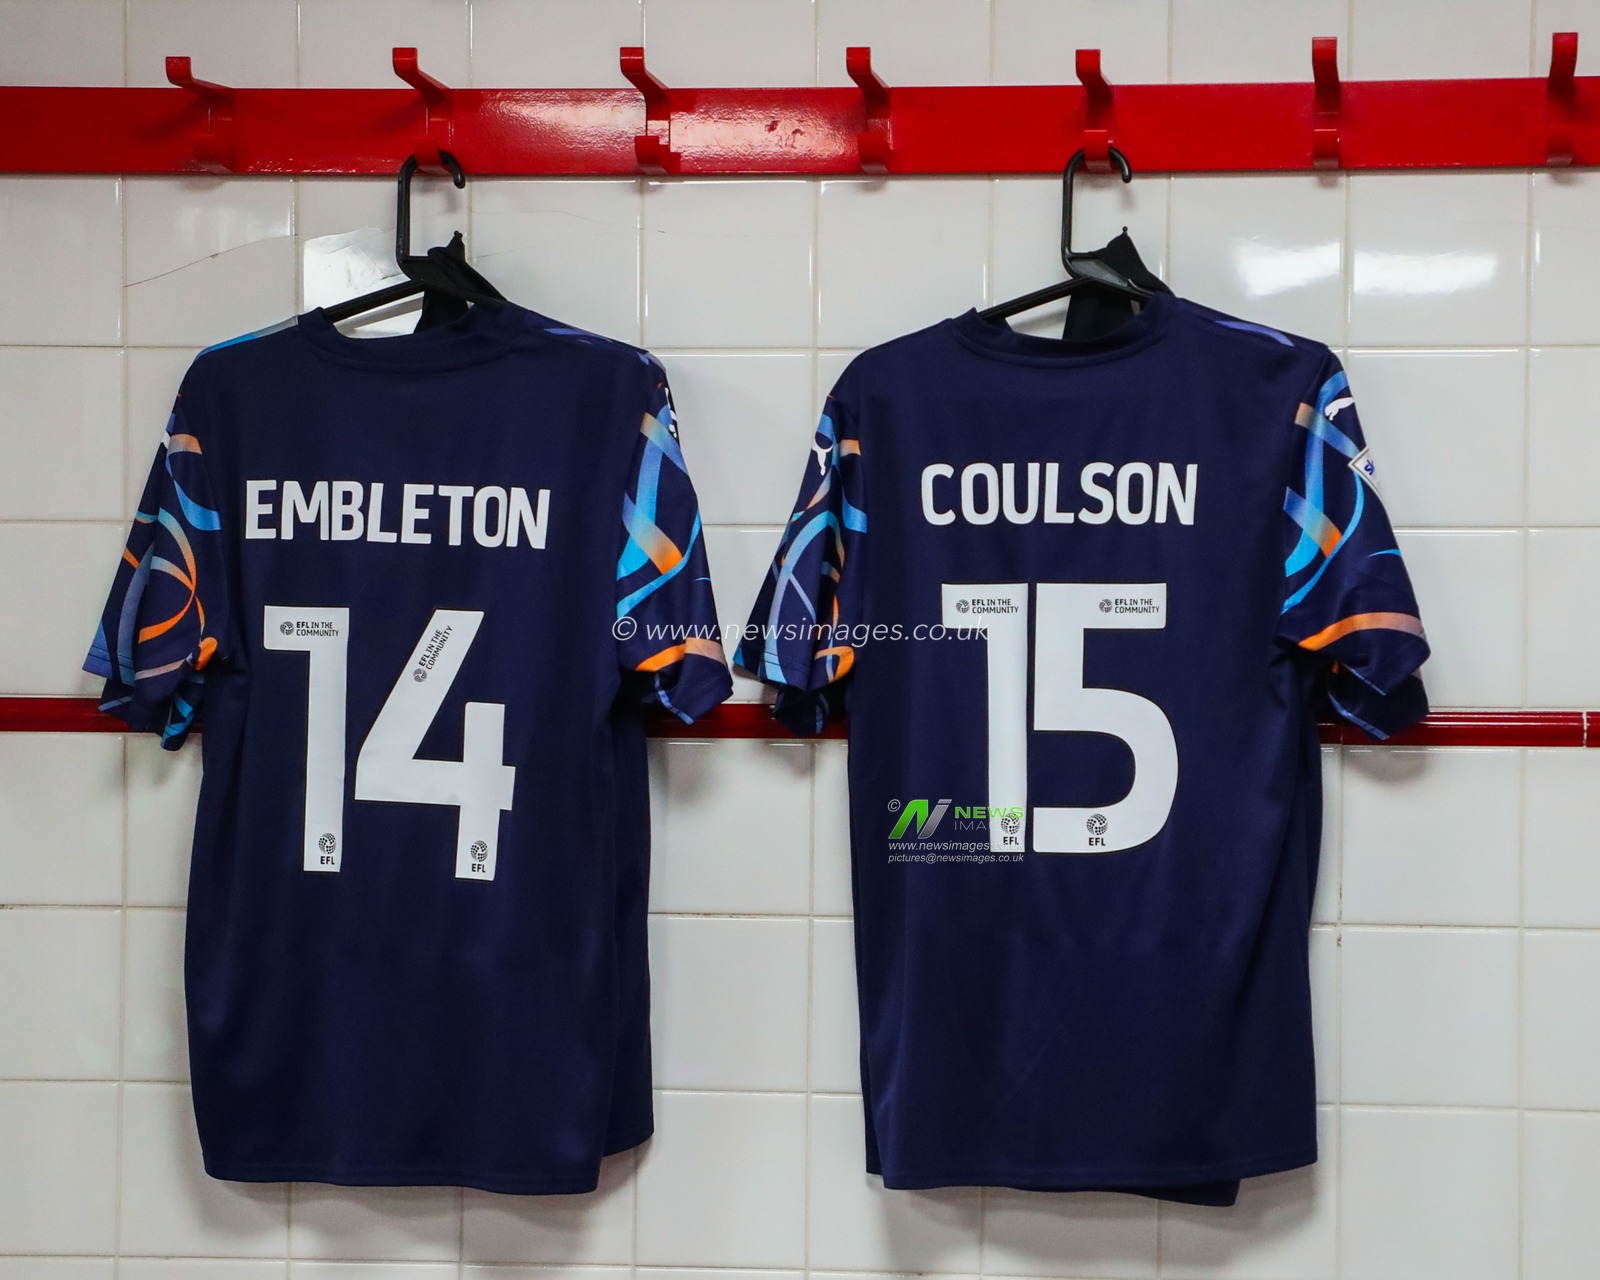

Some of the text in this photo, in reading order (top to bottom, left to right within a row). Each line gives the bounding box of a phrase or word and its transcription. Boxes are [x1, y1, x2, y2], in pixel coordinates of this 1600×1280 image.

[921, 462, 1198, 526] COULSON
[245, 479, 550, 549] EMBLETON
[971, 598, 1012, 606] EFL IN THE
[1114, 598, 1153, 606] EFL IN THE
[972, 606, 1019, 614] COMMUNITY
[1114, 606, 1160, 614] COMMUNITY
[296, 621, 333, 629] EFL IN THE
[418, 629, 443, 667] EFL IN THE
[425, 625, 453, 670] COMMUNITY
[941, 582, 1179, 853] 15
[263, 605, 516, 881] 14
[1003, 836, 1019, 846] EFL
[1088, 837, 1106, 847] EFL
[320, 856, 335, 865] EFL
[471, 863, 486, 873] EFL
